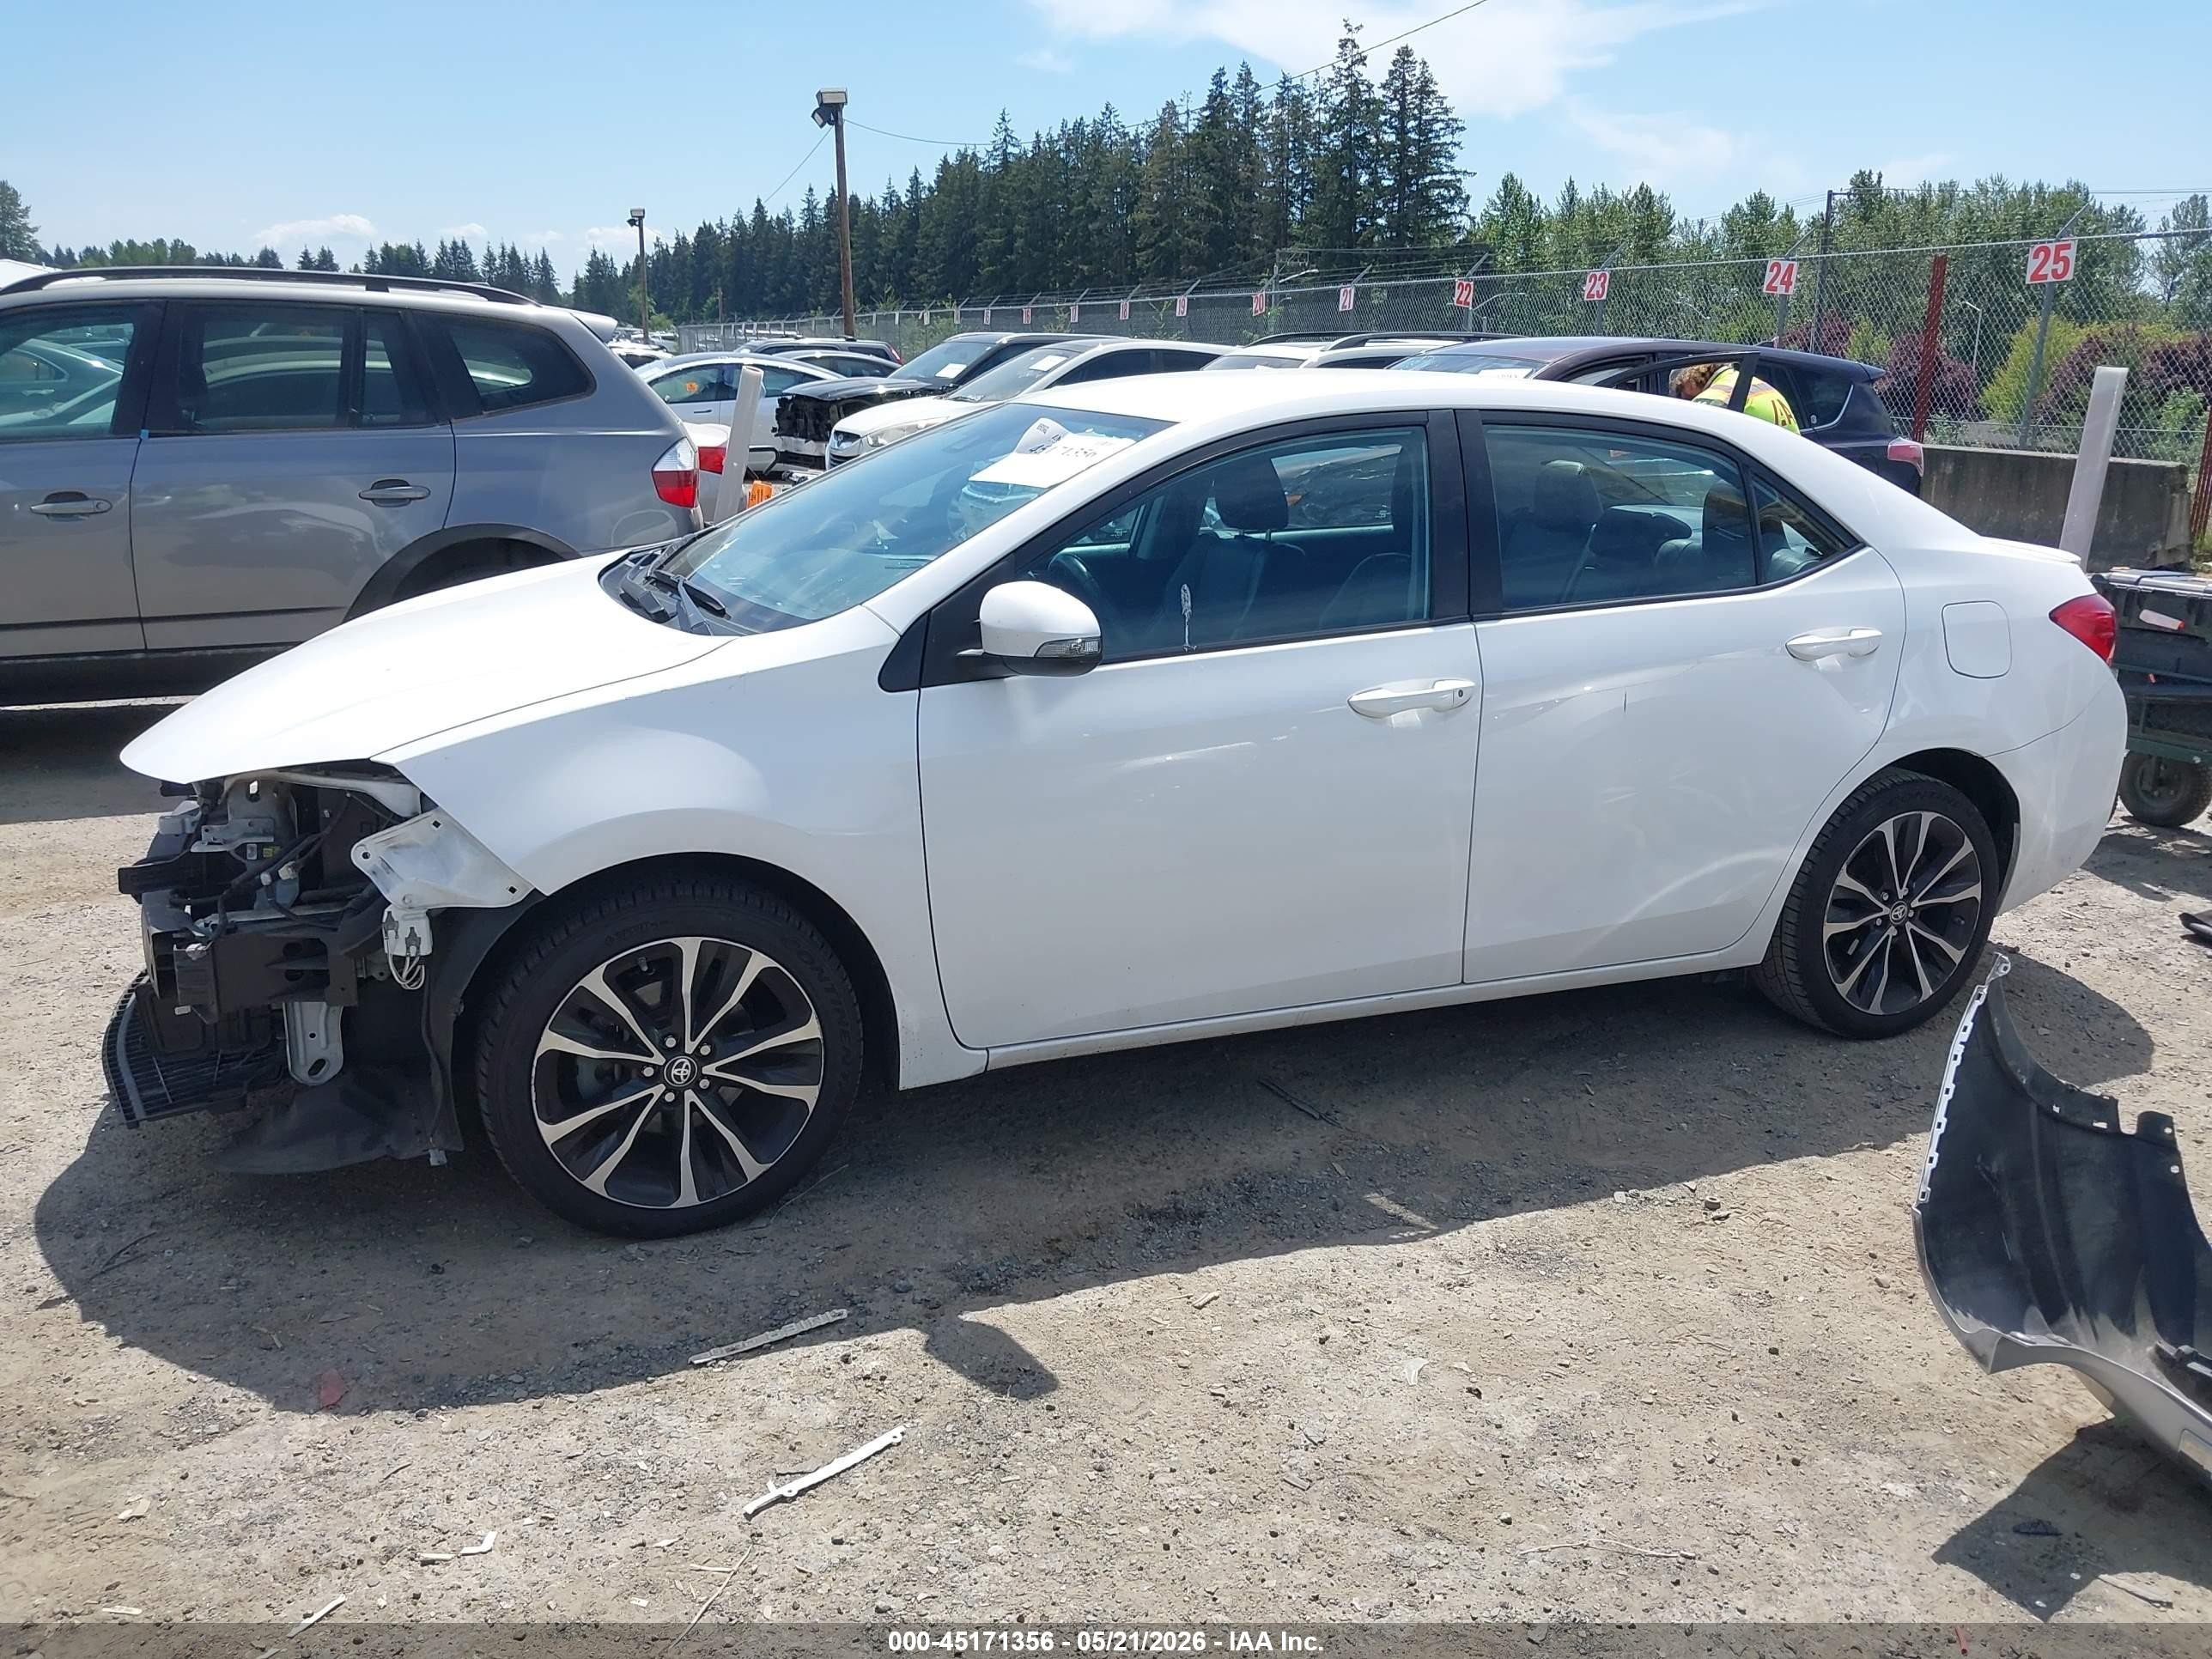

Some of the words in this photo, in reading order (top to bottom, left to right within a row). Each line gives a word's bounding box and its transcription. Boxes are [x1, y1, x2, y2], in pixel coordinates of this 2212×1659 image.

[2029, 242, 2072, 283] 25
[1586, 272, 1607, 300] 23
[1765, 261, 1795, 292] 24
[1177, 296, 1187, 315] 19
[1254, 294, 1265, 314] 20
[1341, 288, 1353, 310] 21
[1455, 282, 1472, 306] 22
[1121, 302, 1128, 319] 18
